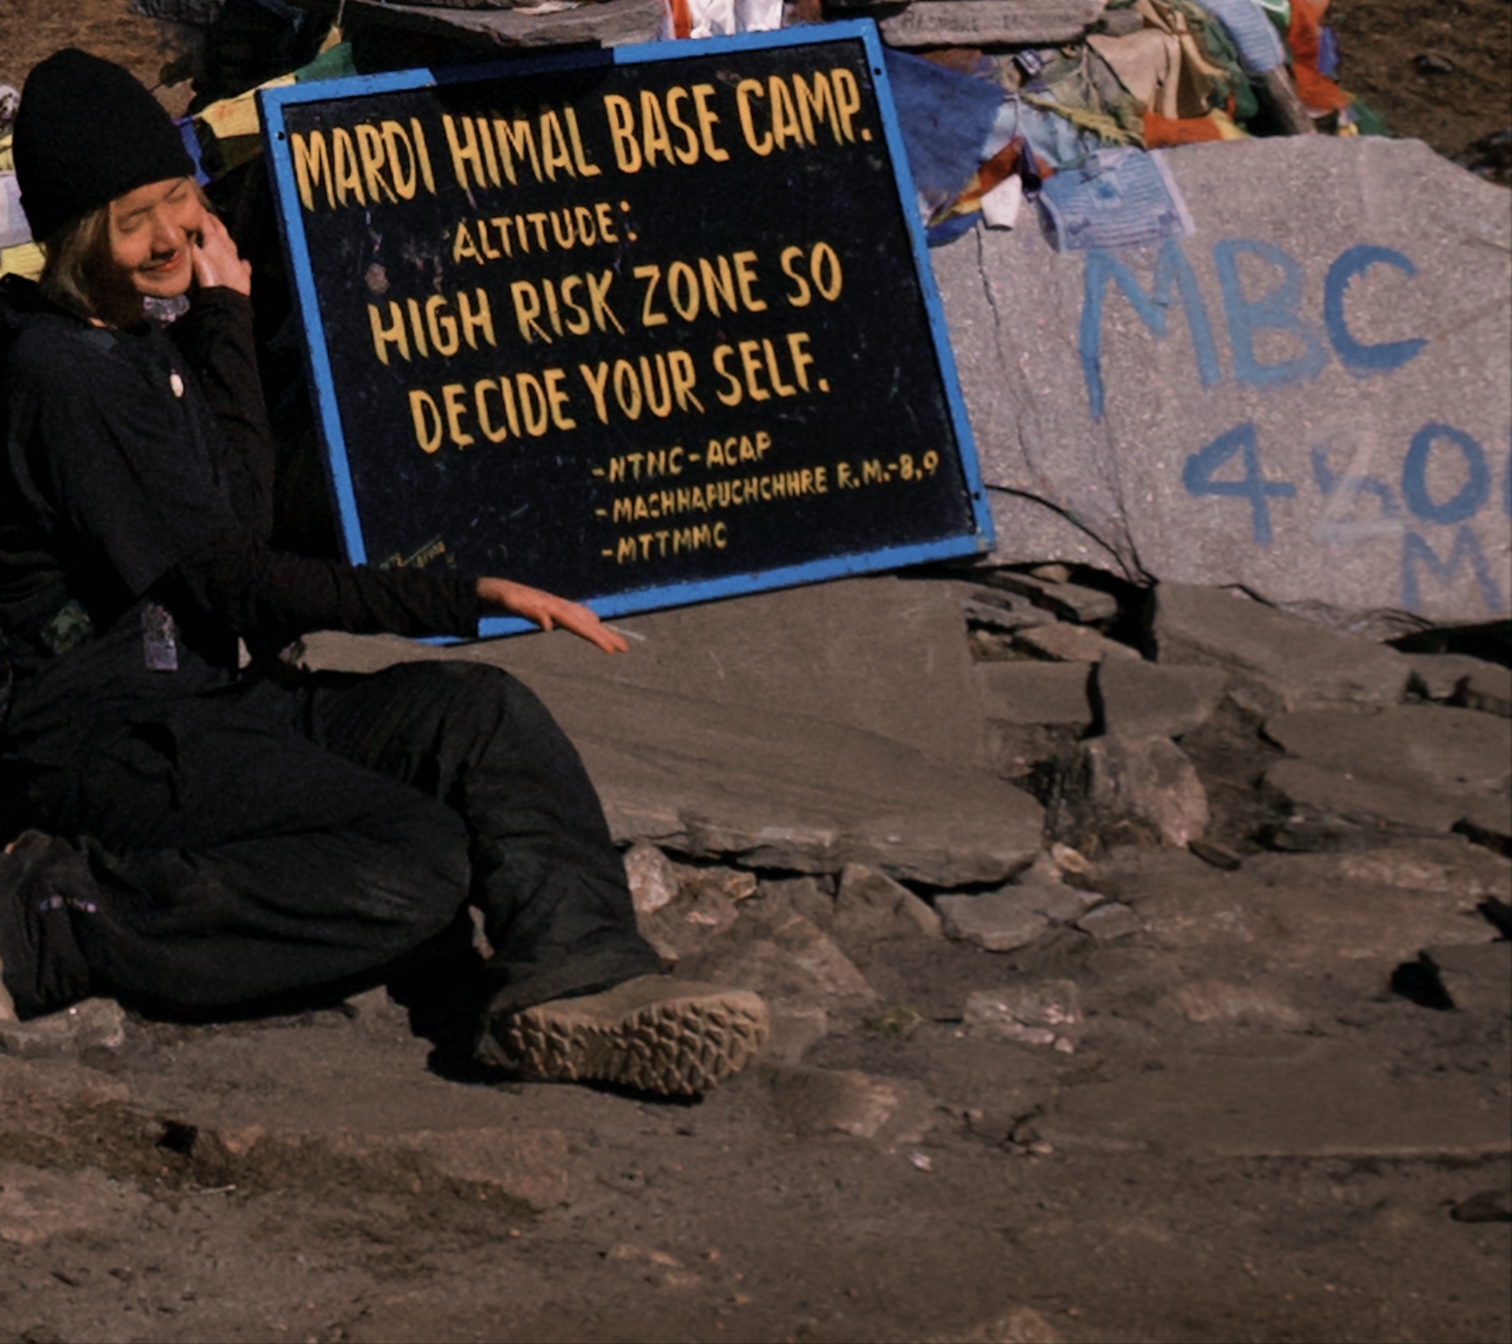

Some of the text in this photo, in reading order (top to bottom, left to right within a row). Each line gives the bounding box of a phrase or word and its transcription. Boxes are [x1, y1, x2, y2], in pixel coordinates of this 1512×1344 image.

[290, 67, 873, 211] MARDI HIMAL BASE CAMP.
[452, 200, 638, 266] ALTITUDE:
[367, 241, 843, 366] HIGH RISK ZONE SO
[1078, 237, 1430, 420] MBC
[408, 331, 830, 454] DECIDE YOUR SELF.
[1402, 526, 1502, 612] M
